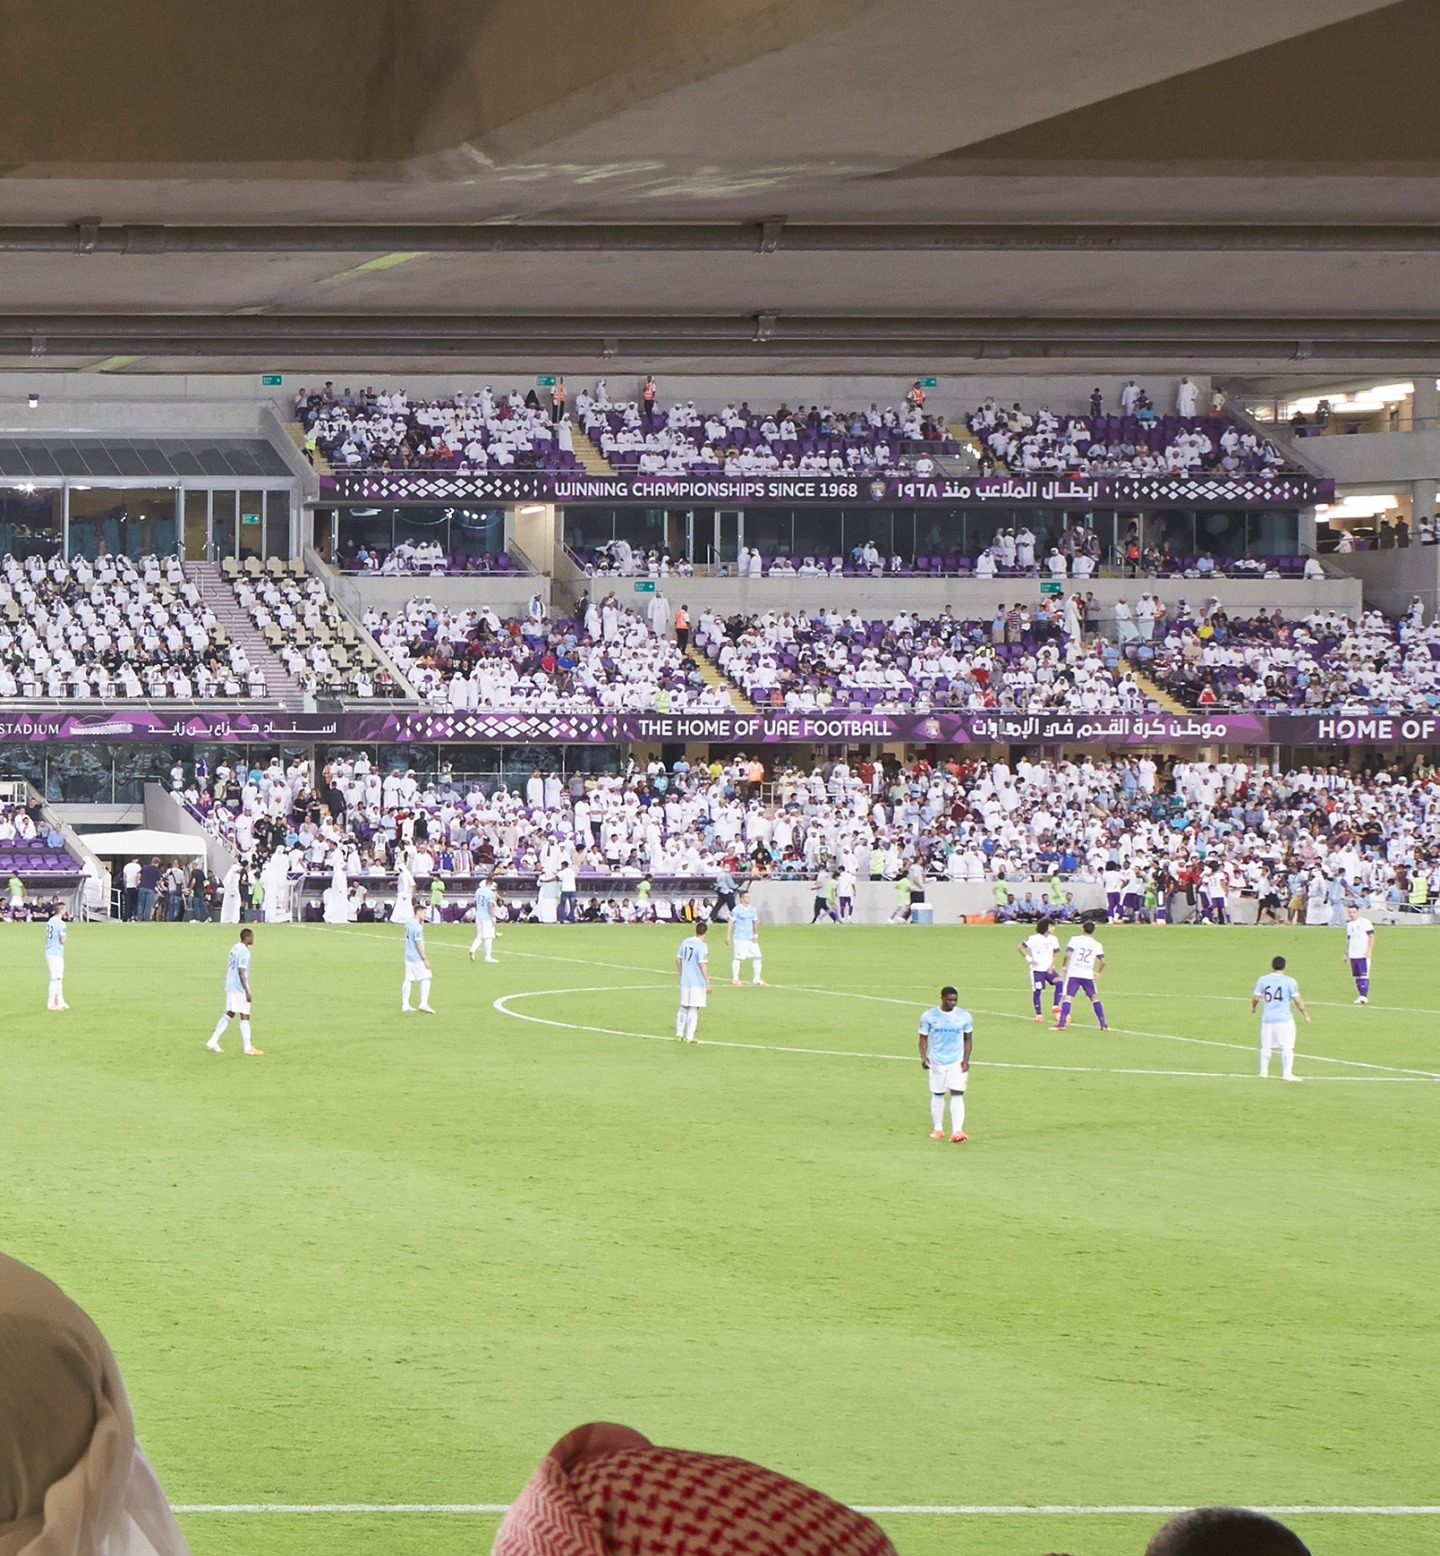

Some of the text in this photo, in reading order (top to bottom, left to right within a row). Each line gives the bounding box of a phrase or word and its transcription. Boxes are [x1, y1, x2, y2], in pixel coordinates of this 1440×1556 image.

[554, 482, 858, 498] WINNING CHAMPIONSHIPS SINCE 1968
[897, 483, 938, 498] ١٩٦٨
[941, 481, 971, 499] منذ
[147, 721, 337, 737] استاد هزاع بن زايد
[638, 719, 893, 737] THE HOME OF UAE FOOTBALL
[1042, 718, 1074, 738] في
[1076, 717, 1130, 739] القدم
[1132, 717, 1167, 739] كرة
[1169, 718, 1227, 740] موطن
[1318, 719, 1436, 740] HOME OF
[683, 946, 694, 963] 17
[1077, 947, 1092, 963] 32
[1263, 984, 1284, 1004] 64
